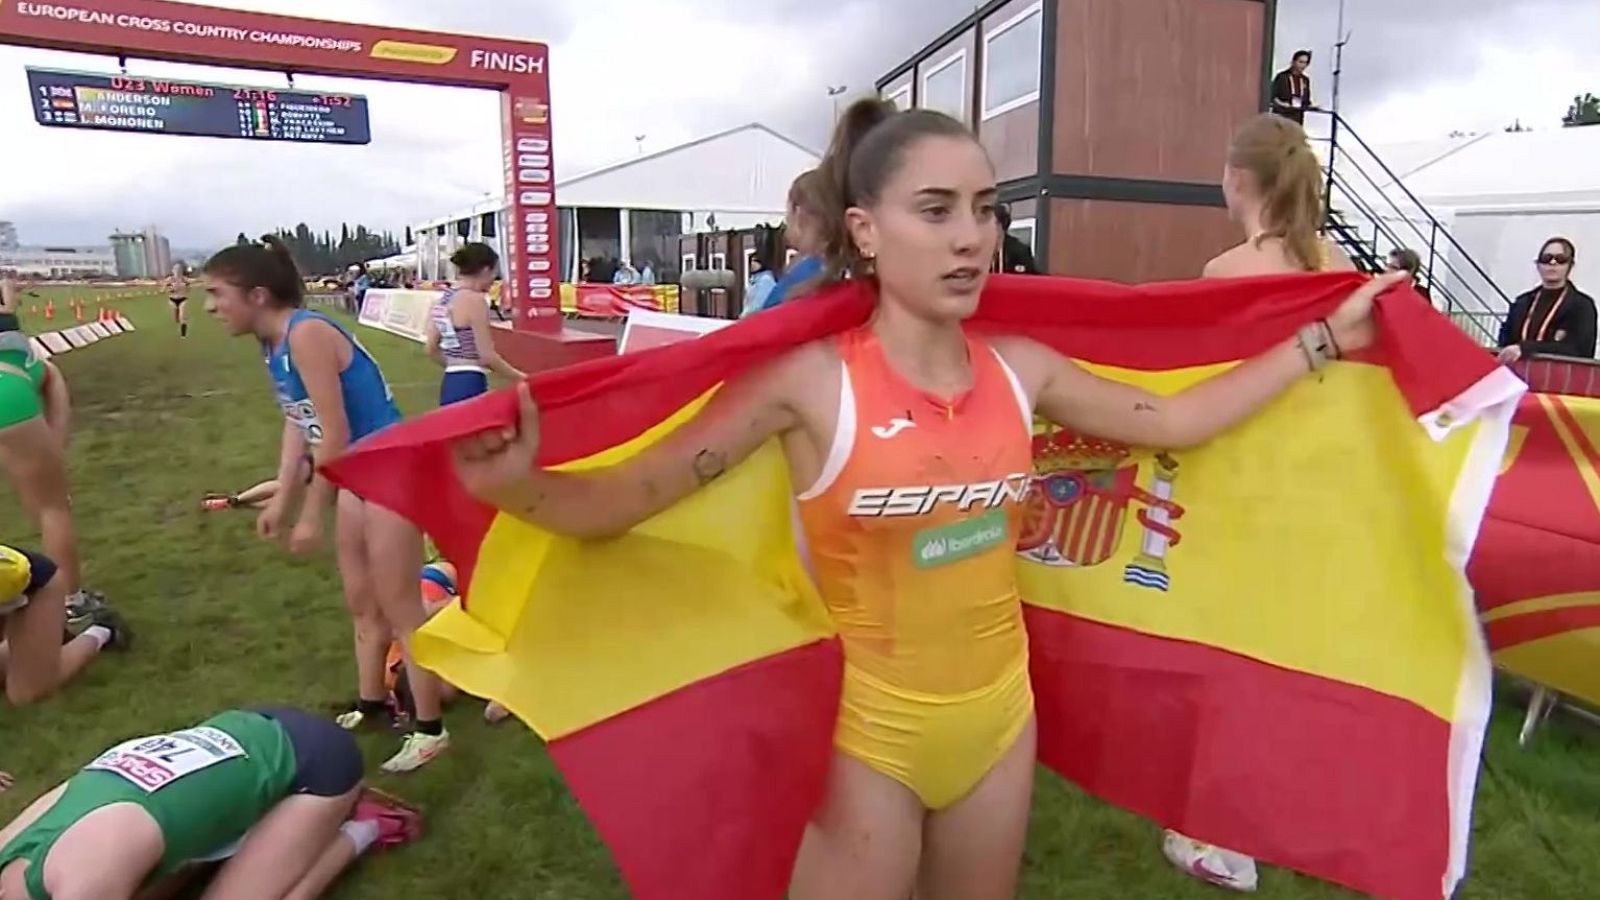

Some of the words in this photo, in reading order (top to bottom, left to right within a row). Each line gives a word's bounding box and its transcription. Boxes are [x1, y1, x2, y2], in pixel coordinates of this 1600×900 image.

[17, 2, 114, 25] EUROPEAN
[117, 15, 171, 32] CROSS
[173, 22, 248, 41] COUNTRY
[250, 31, 362, 52] CHAMPIONSHIPS
[470, 50, 543, 74] FINISH
[111, 77, 146, 92] U23
[152, 81, 215, 97] Women
[96, 91, 171, 107] ANDERSON
